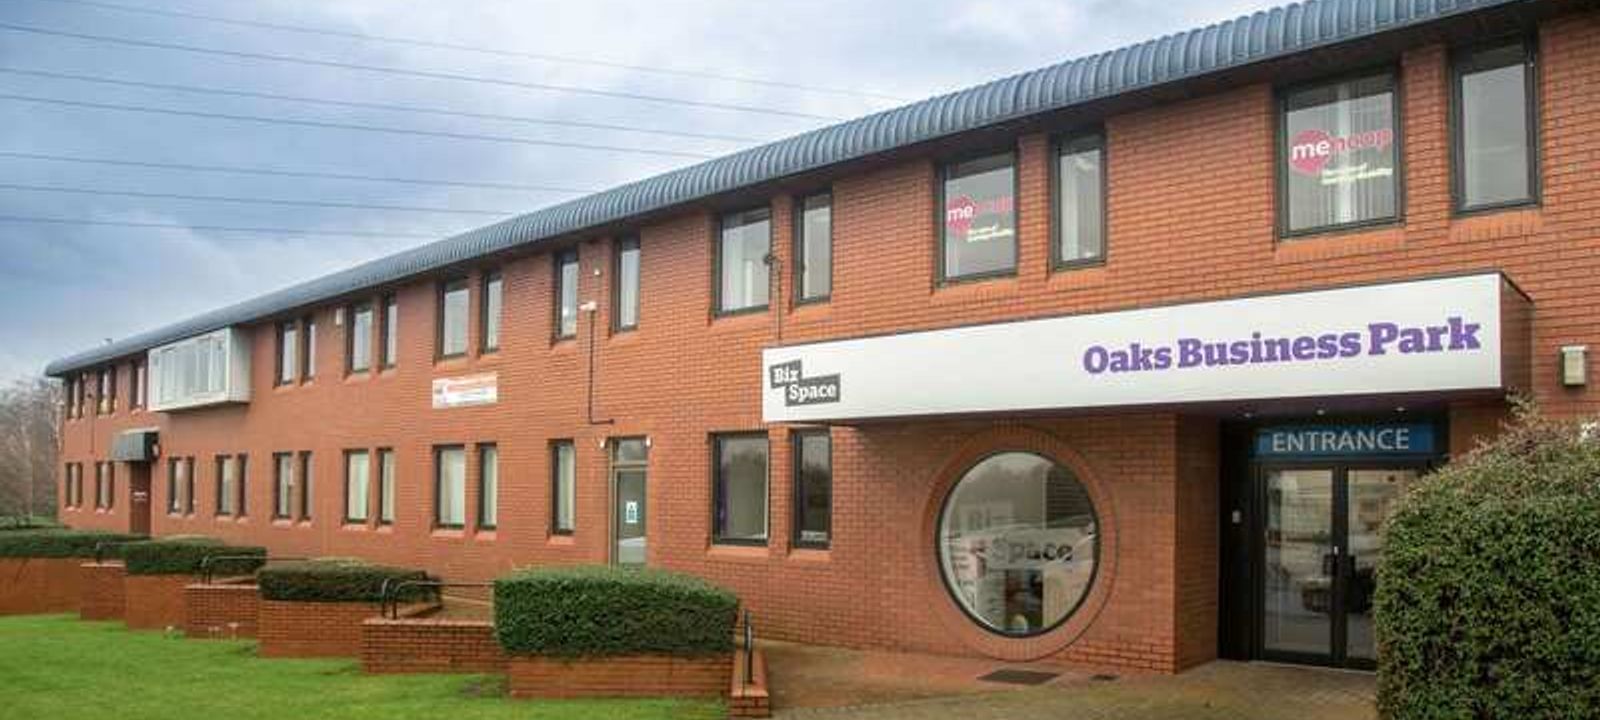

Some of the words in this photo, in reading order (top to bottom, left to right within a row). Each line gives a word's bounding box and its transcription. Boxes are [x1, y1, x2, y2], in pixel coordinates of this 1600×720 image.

[1083, 343, 1172, 373] Oaks
[1178, 332, 1361, 368] Business
[1368, 317, 1481, 355] Park
[774, 365, 800, 383] Biz
[788, 384, 837, 403] Space
[1272, 428, 1409, 451] ENTRANCE
